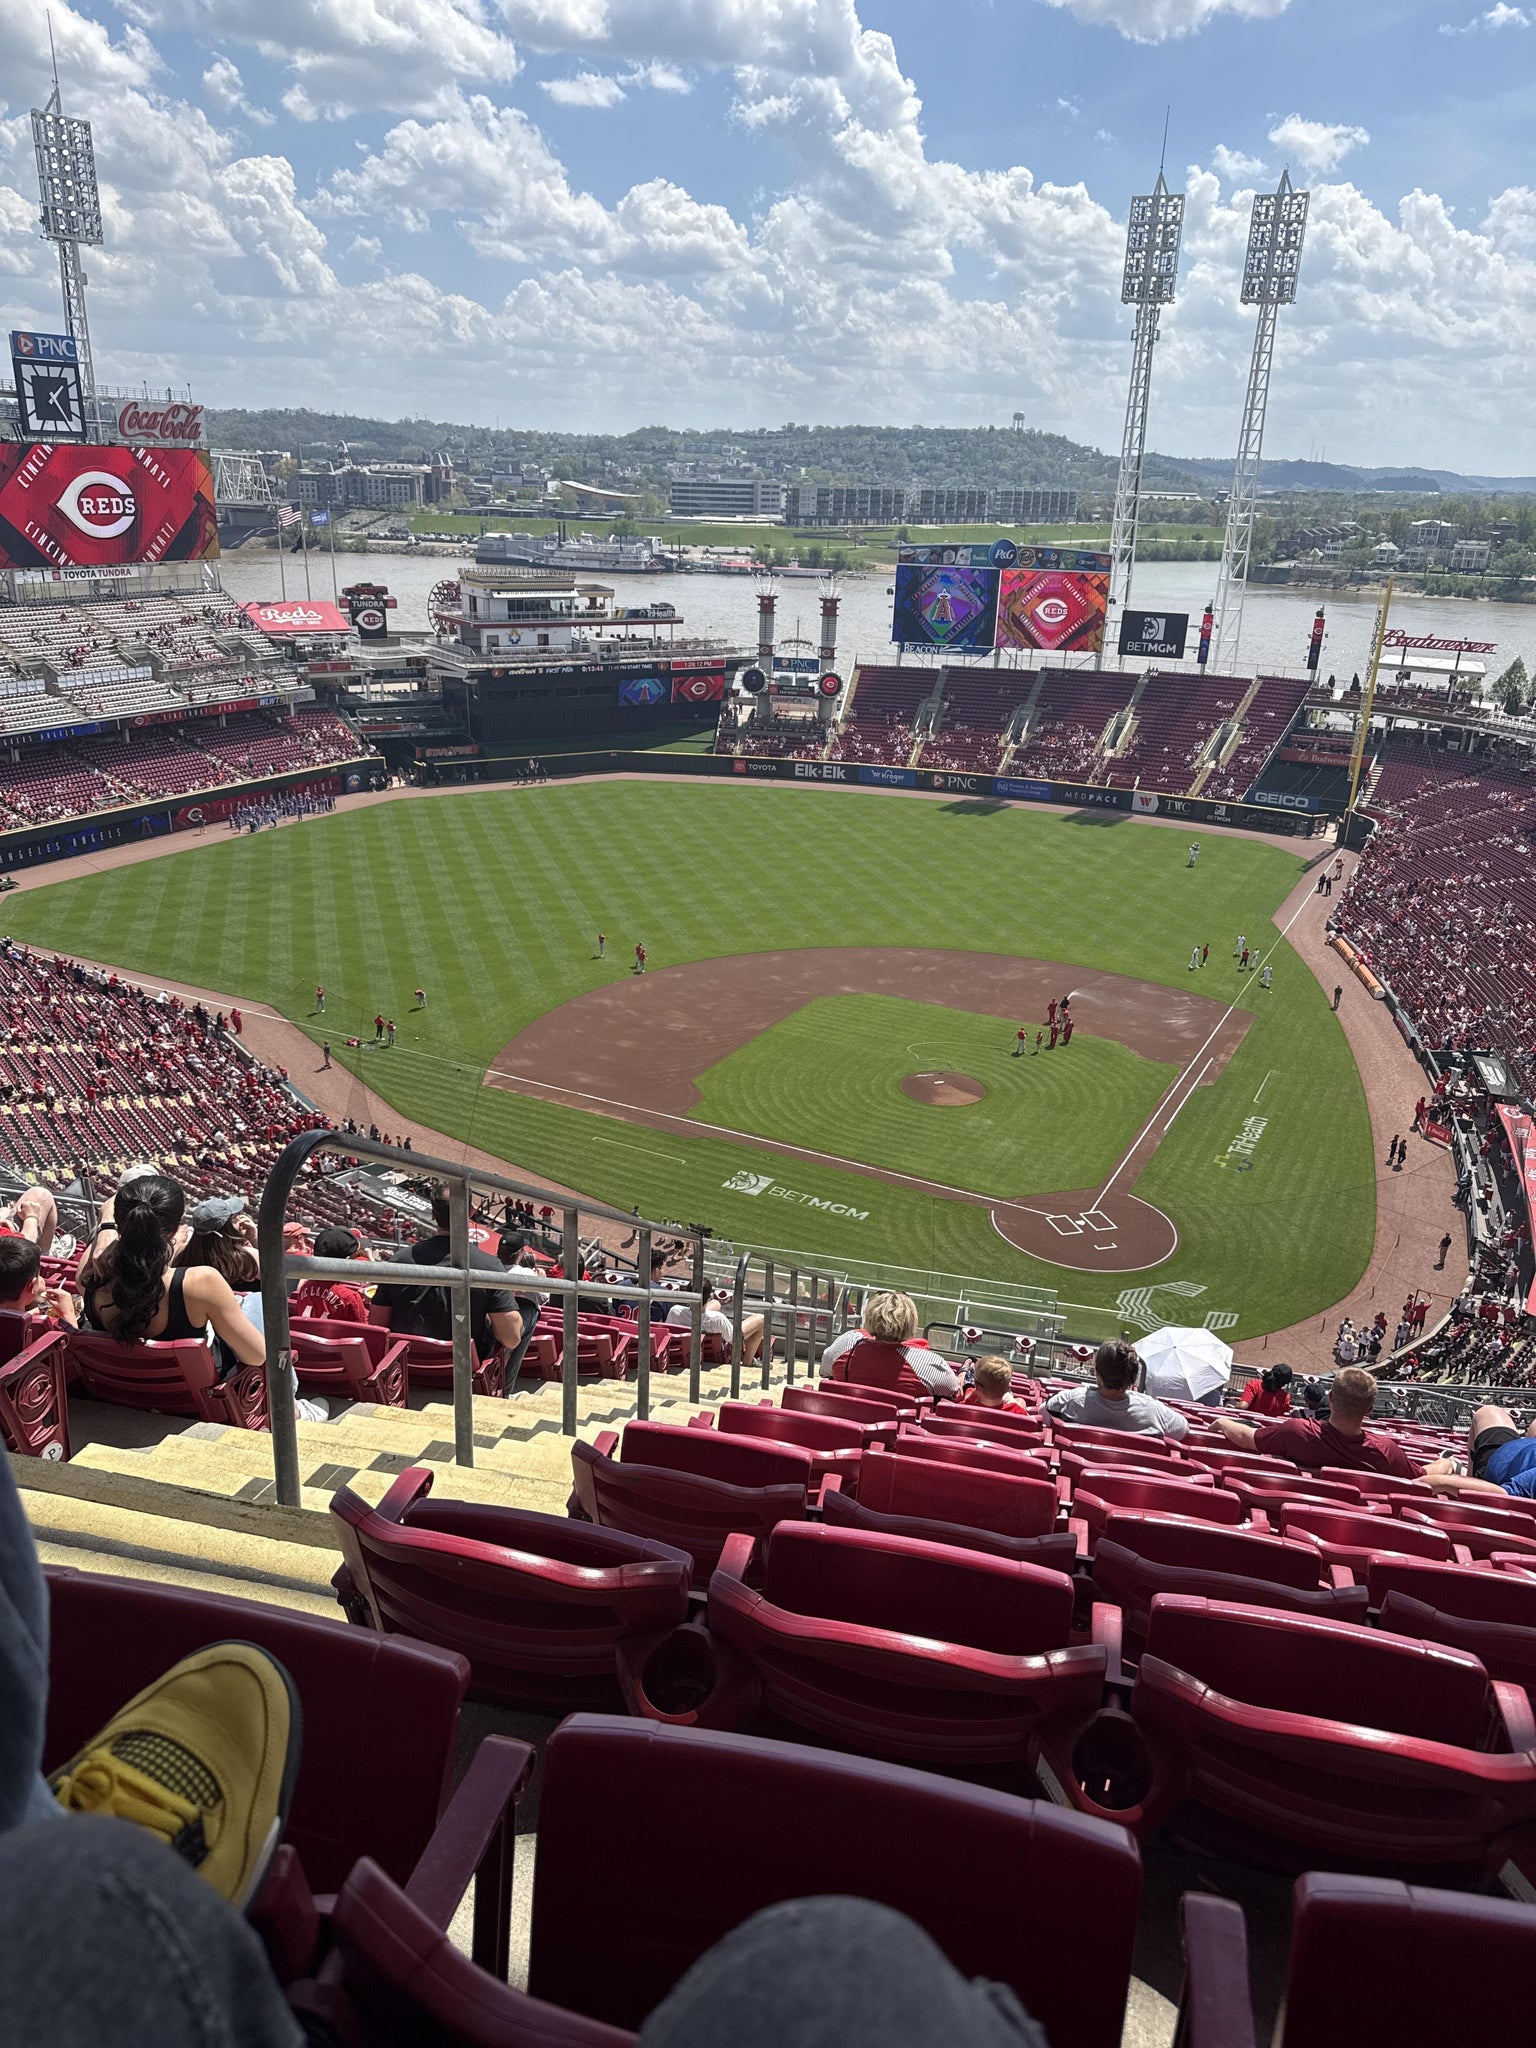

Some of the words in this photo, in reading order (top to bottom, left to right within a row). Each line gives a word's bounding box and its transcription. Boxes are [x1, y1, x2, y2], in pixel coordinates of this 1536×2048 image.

[35, 336, 76, 357] PNC
[118, 401, 204, 440] Coca-Cola
[80, 497, 136, 515] REDS
[994, 548, 1015, 560] P&G
[63, 570, 96, 580] TOYOTA
[97, 568, 132, 578] TUNDRA
[351, 600, 385, 608] TUNDRA
[259, 606, 324, 624] Reds
[646, 609, 675, 618] TriHealth
[1044, 607, 1068, 615] REDS
[904, 642, 938, 654] BEACON
[1126, 641, 1177, 654] BETMGM
[790, 660, 812, 669] PNC
[747, 763, 777, 772] TOYOTA
[881, 769, 905, 783] Kroger
[947, 775, 977, 790] PNC
[1065, 791, 1118, 804] MEDPACE
[1139, 796, 1152, 807] W
[1254, 791, 1309, 809] GEICO
[1165, 799, 1192, 812] TWC
[1206, 814, 1231, 823] BETMGM
[72, 828, 122, 848] ANGELS
[1228, 1115, 1269, 1155] TriHealth
[768, 1185, 870, 1221] BETMGM
[321, 1288, 346, 1310] CRUZ
[48, 1448, 56, 1460] P
